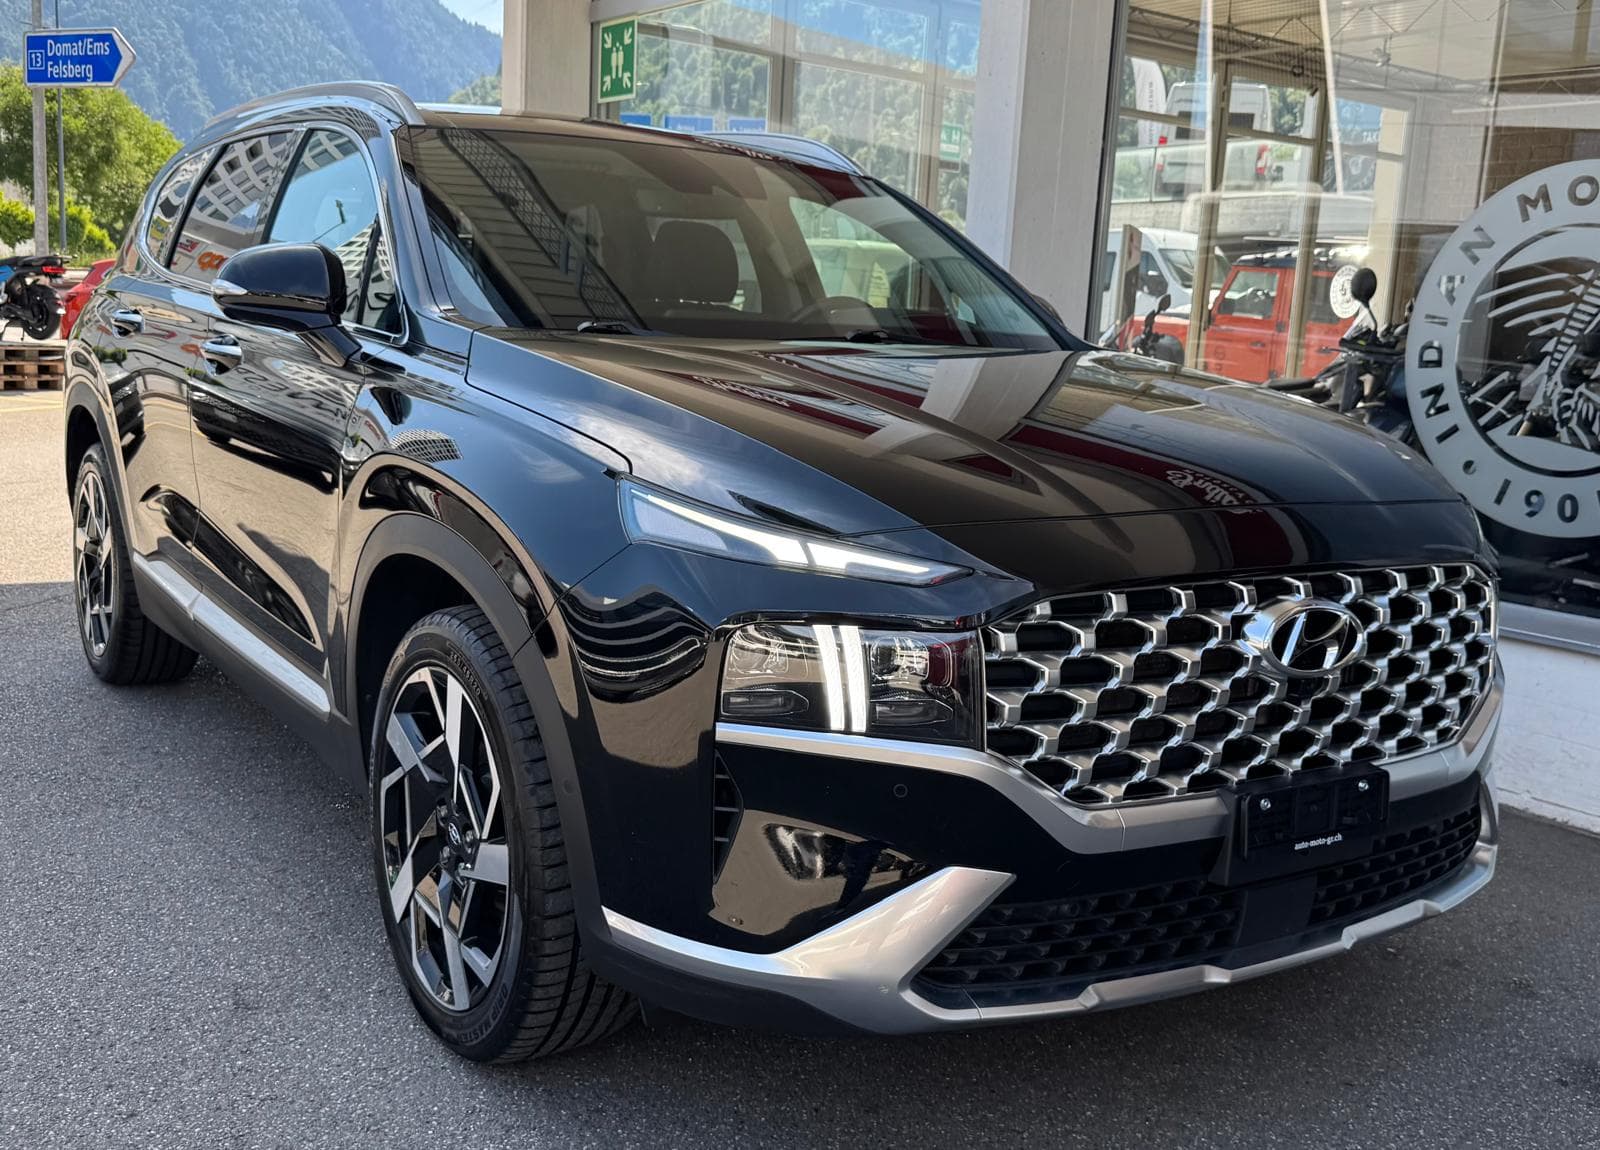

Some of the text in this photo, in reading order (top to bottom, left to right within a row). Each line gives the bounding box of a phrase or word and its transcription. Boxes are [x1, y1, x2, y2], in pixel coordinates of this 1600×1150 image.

[47, 38, 110, 57] Domat/Ems
[31, 53, 42, 67] 13
[47, 60, 93, 82] Felsberg
[1418, 224, 1496, 445] INDIAN
[1494, 478, 1600, 523] 190
[1294, 832, 1343, 851] auto-moto-gr.ch
